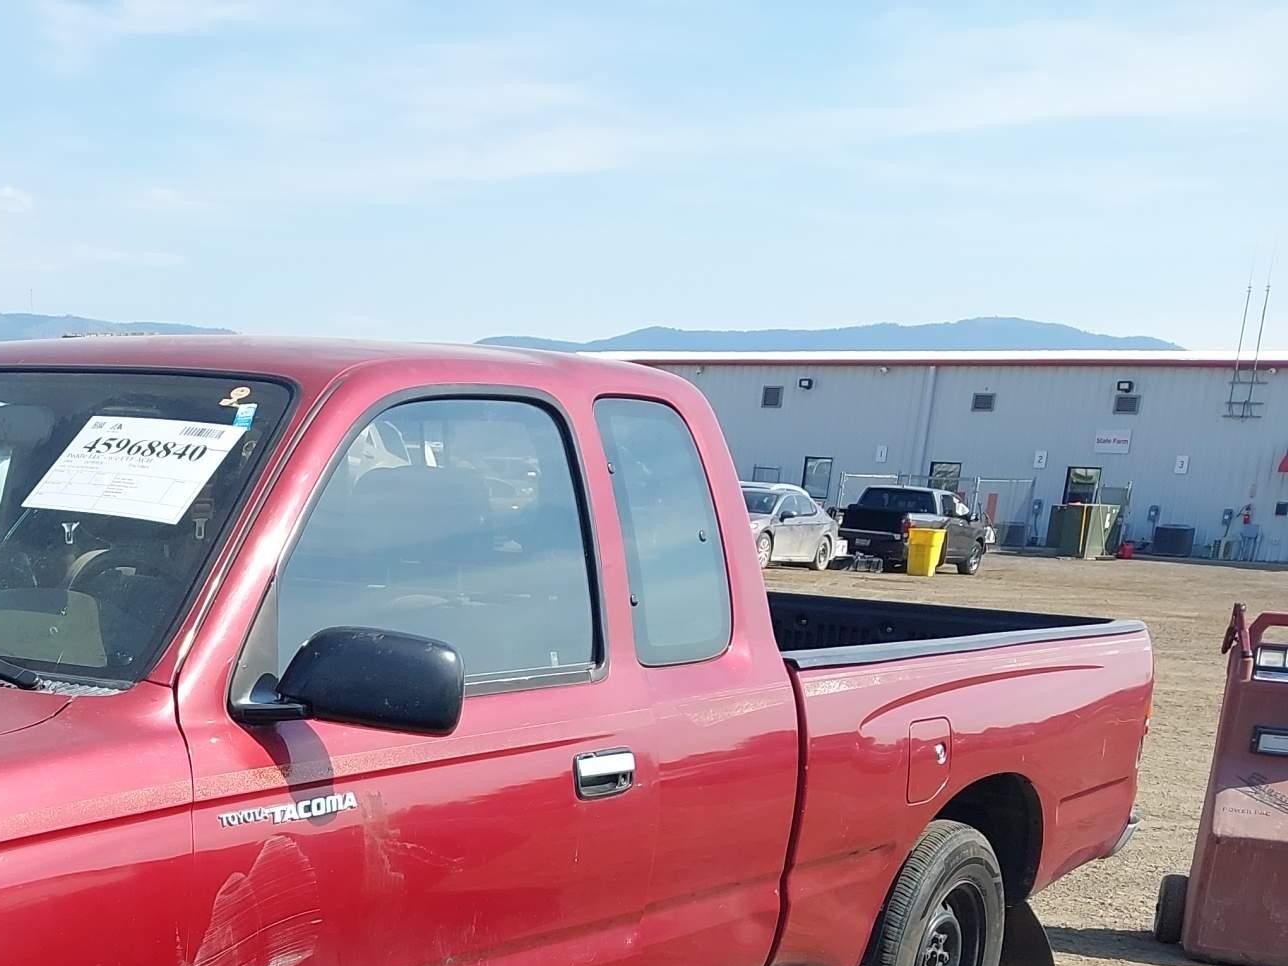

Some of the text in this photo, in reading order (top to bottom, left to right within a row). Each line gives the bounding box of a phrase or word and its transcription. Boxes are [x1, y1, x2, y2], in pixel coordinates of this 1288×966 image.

[82, 436, 208, 462] 45968840
[217, 791, 358, 828] TOYOTA TACOMA
